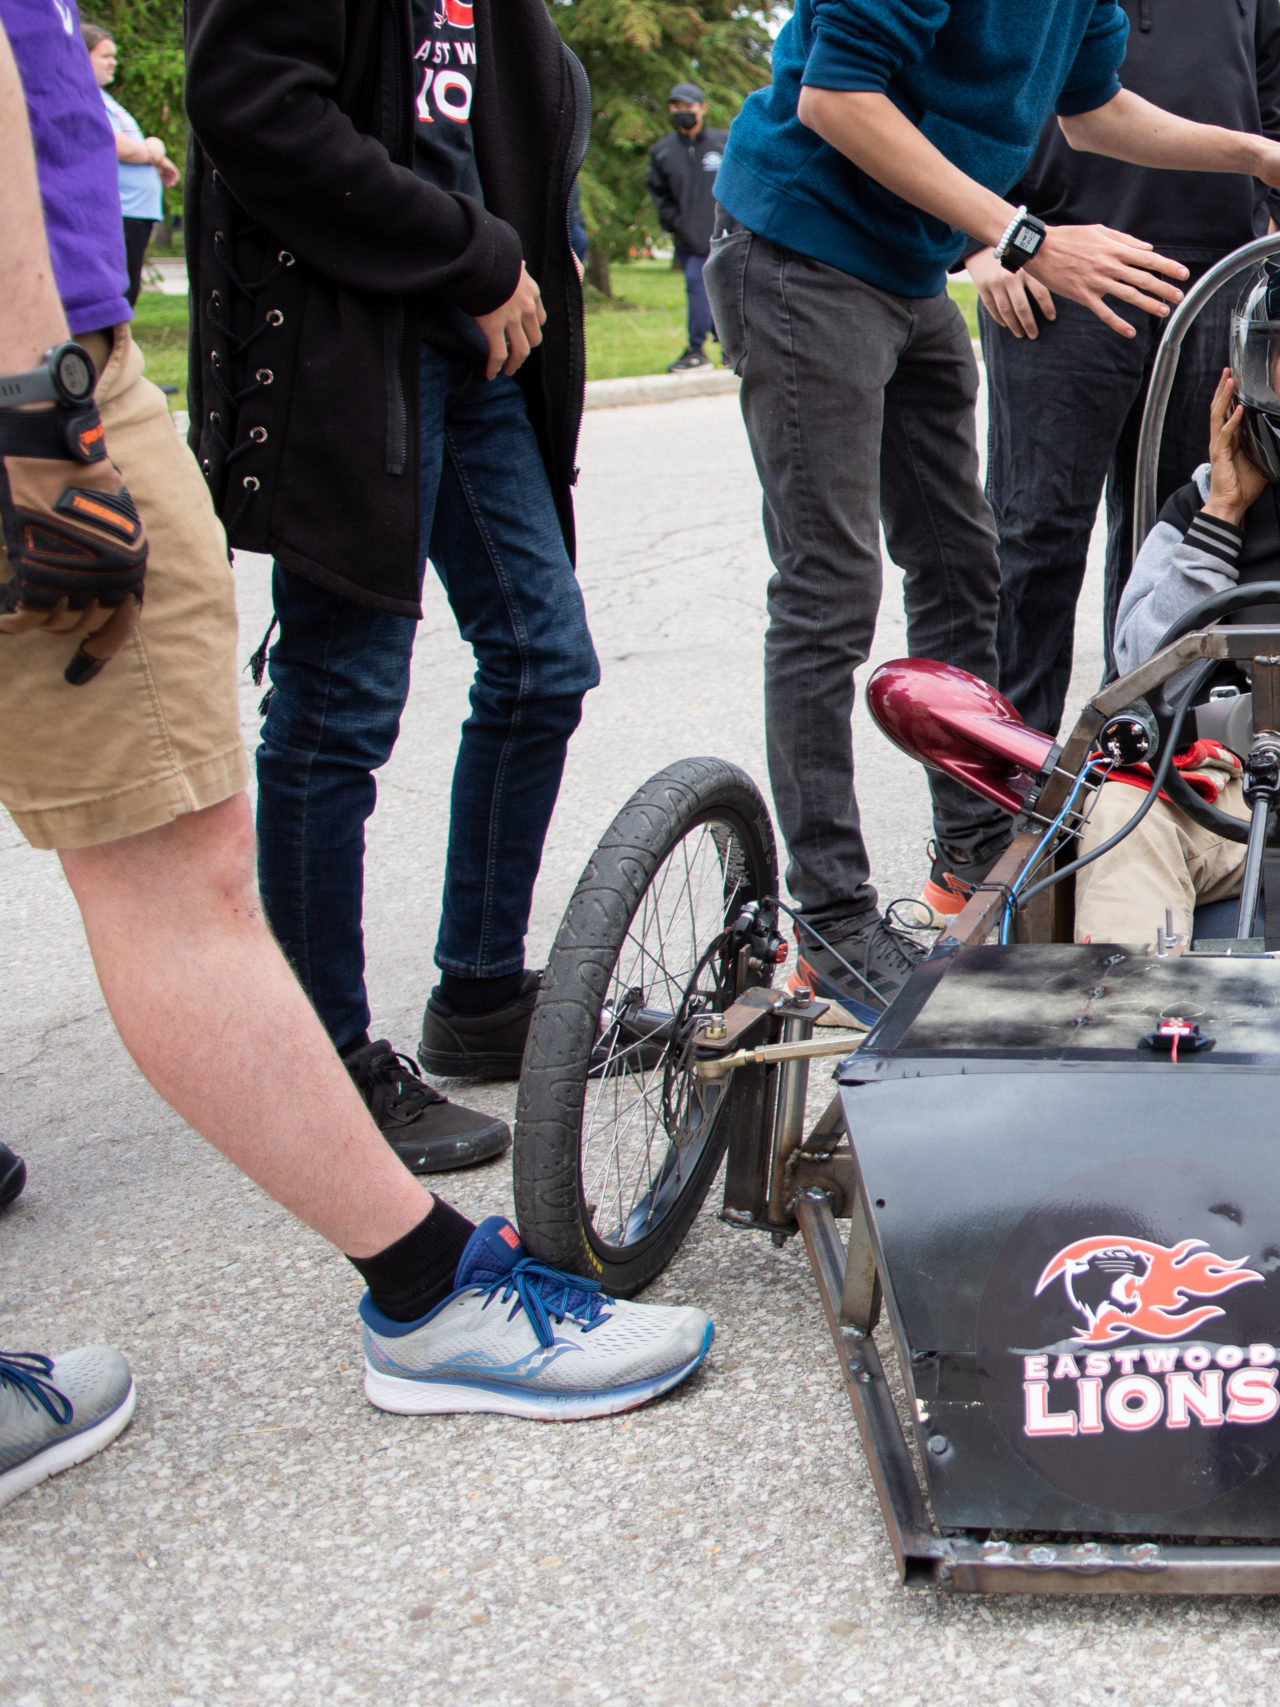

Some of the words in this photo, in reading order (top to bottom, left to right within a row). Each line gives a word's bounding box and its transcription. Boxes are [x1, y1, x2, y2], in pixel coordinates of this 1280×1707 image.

[413, 39, 477, 65] ASTW
[1024, 1342, 1277, 1380] EASTWOOD
[1023, 1365, 1280, 1437] LIONS
